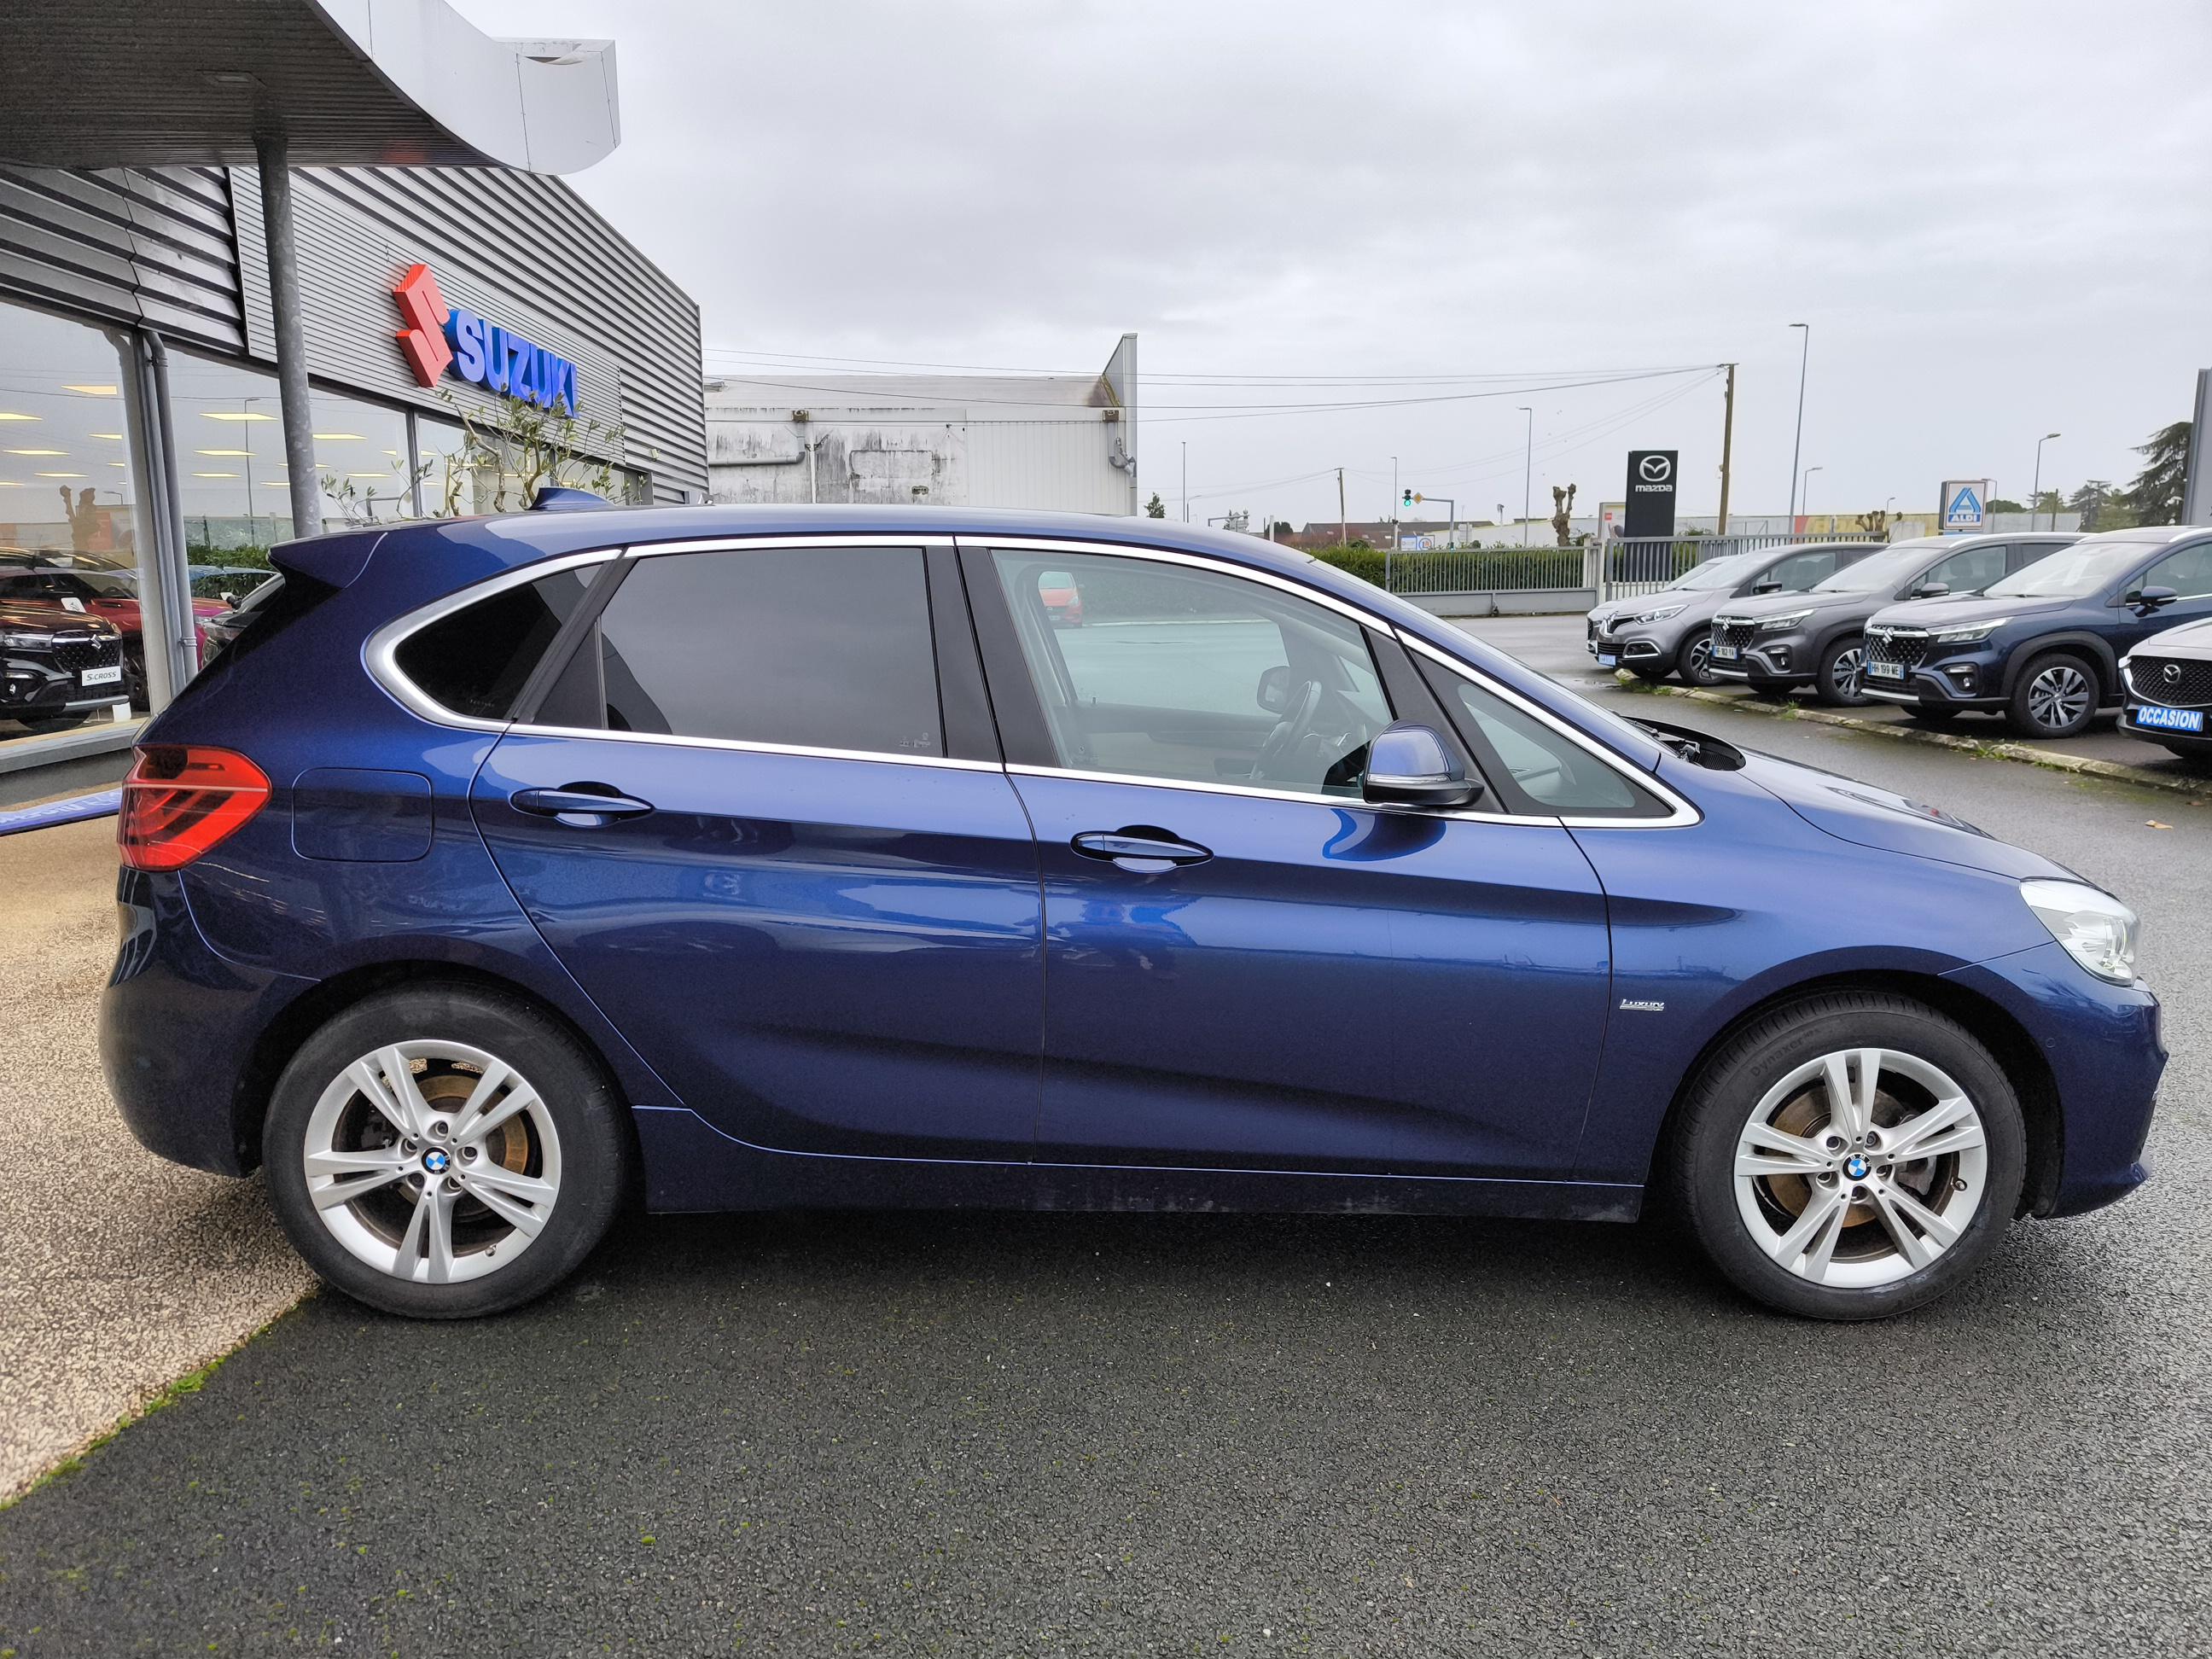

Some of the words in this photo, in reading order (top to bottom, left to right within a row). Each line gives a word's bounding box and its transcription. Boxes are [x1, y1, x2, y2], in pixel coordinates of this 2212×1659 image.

[452, 308, 580, 419] SUZUKI
[1952, 514, 1977, 522] ALDI
[2139, 707, 2200, 729] OCCASION
